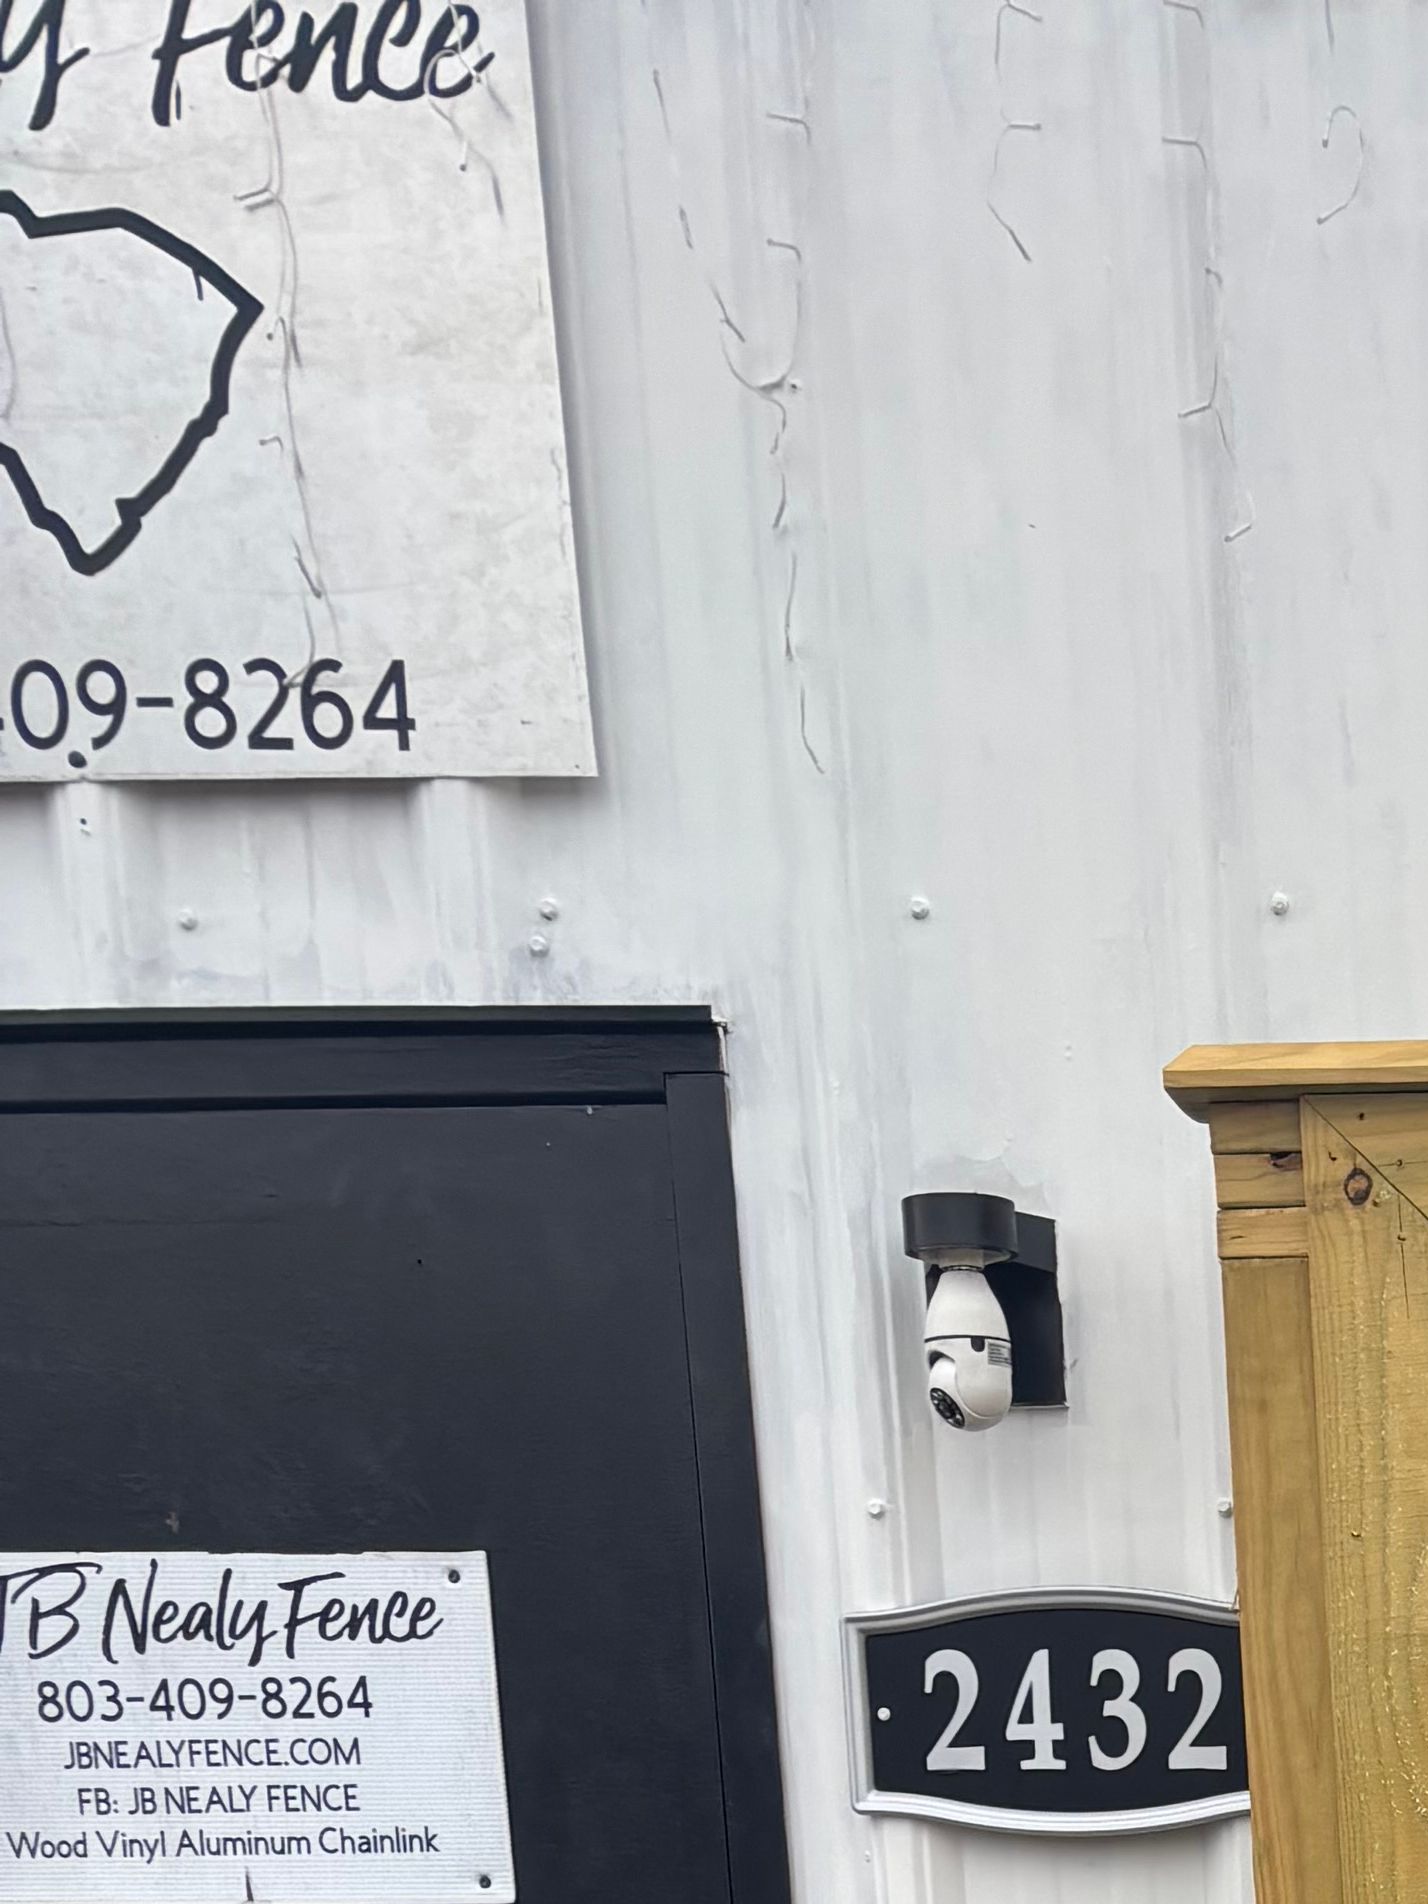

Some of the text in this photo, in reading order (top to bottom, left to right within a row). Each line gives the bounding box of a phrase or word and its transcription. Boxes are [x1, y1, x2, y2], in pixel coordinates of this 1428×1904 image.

[0, 657, 417, 752] 09-8264
[102, 1558, 278, 1666] Nealy
[277, 1572, 444, 1660] Fence
[38, 1675, 373, 1723] 803-409-8264
[924, 1648, 1228, 1771] 2432
[64, 1737, 361, 1770] JBNEALYFENCE.COM
[78, 1784, 360, 1815] FB: JB NEALY FENCE
[6, 1826, 440, 1864] Wood Vinyl Aluminum Chainlink
